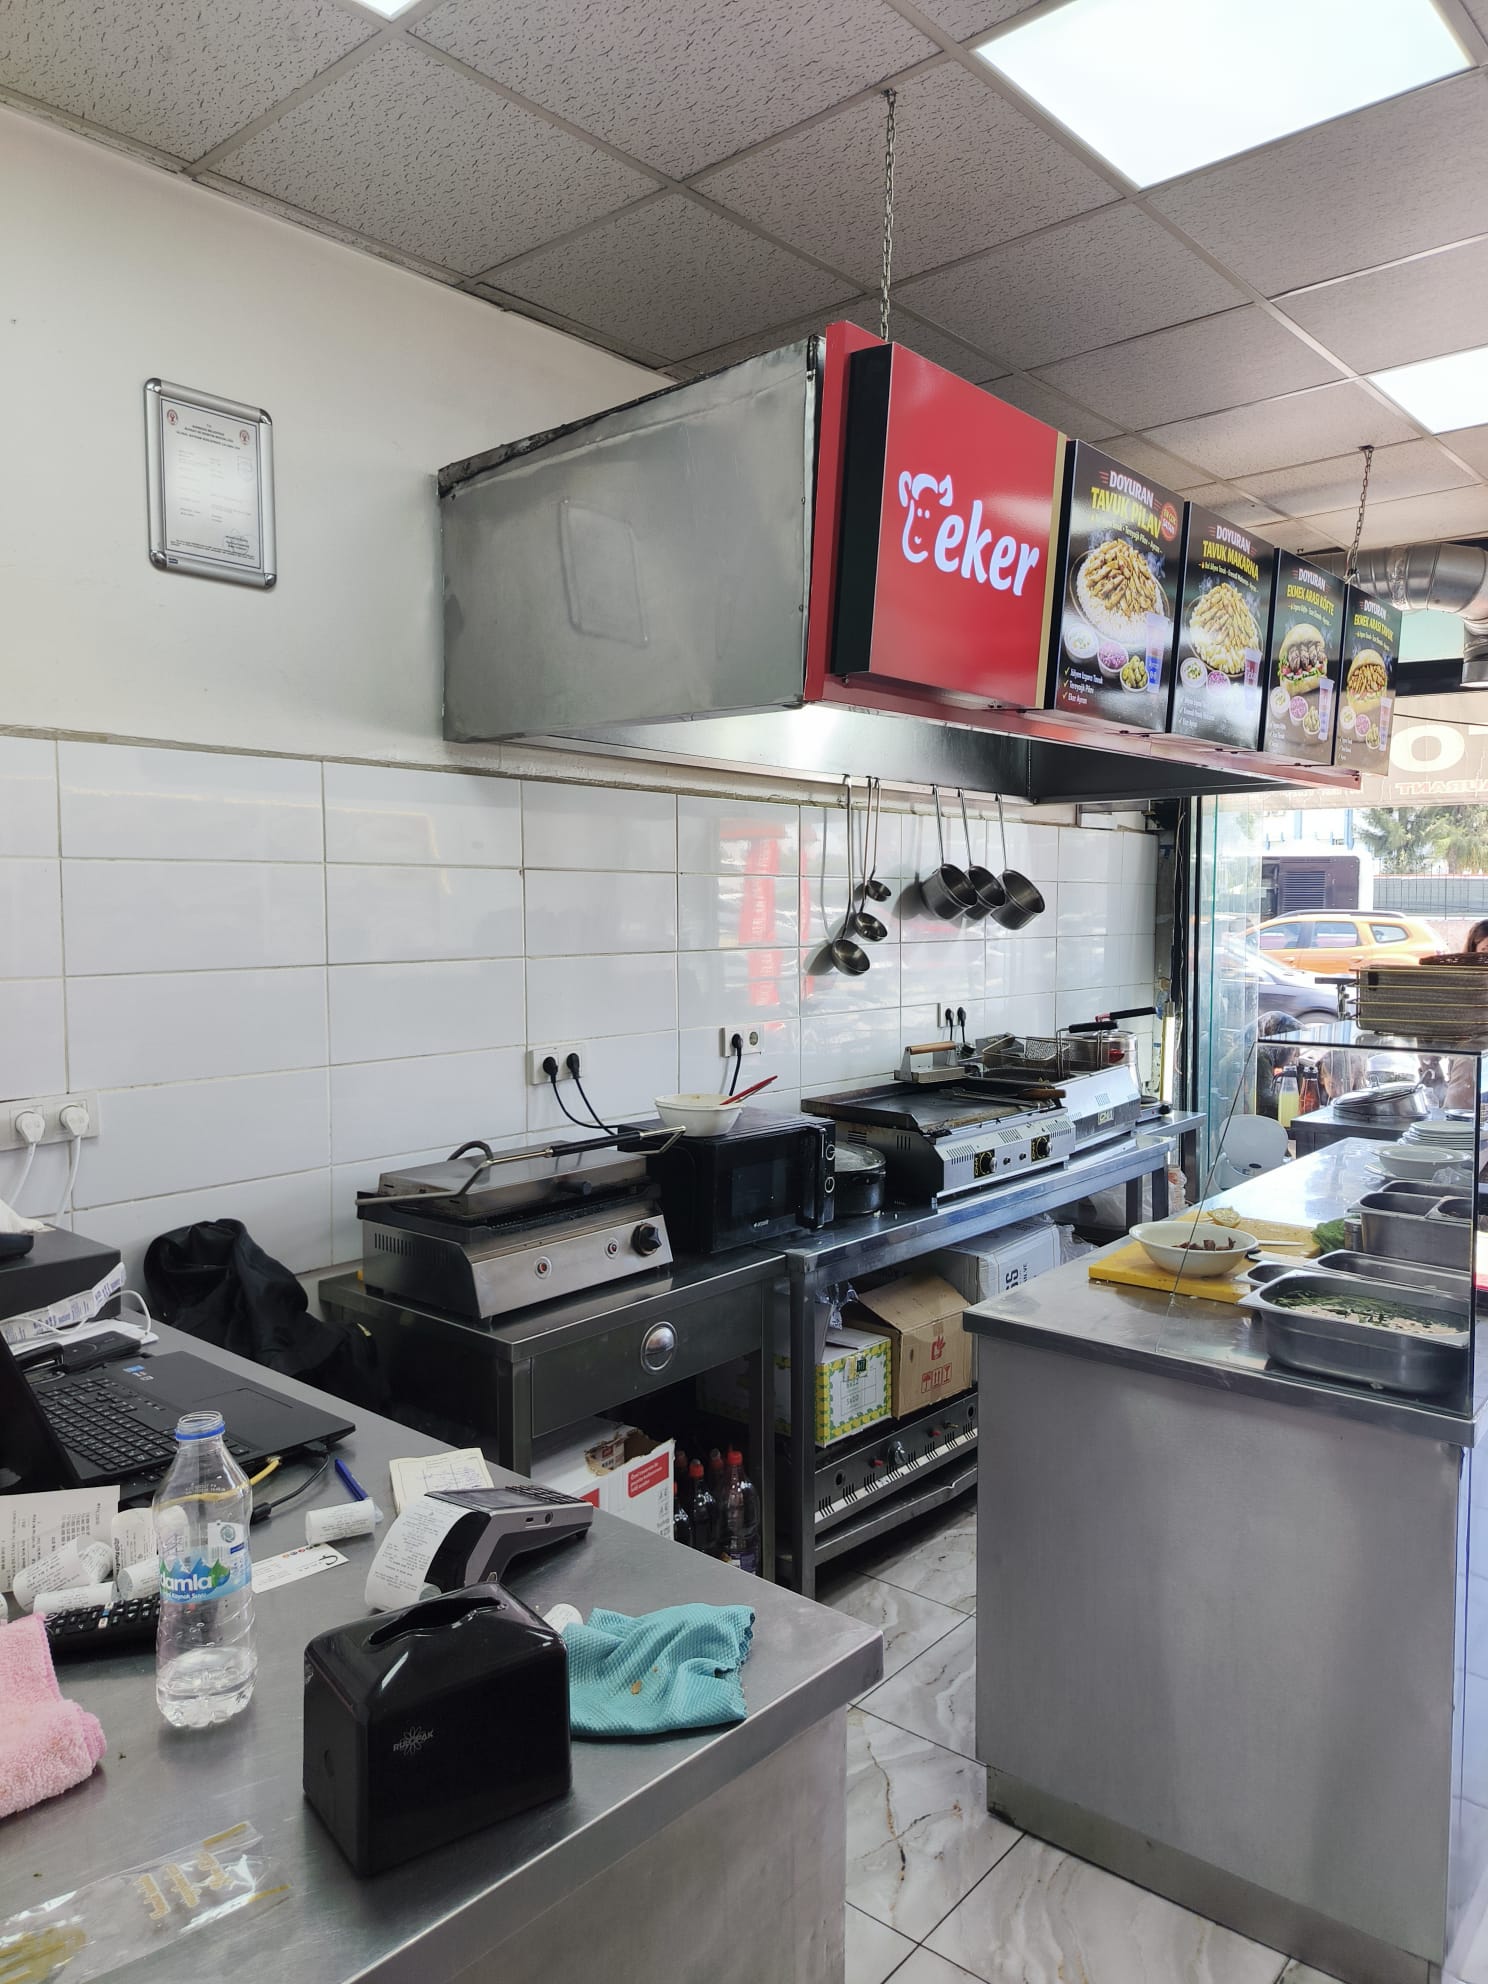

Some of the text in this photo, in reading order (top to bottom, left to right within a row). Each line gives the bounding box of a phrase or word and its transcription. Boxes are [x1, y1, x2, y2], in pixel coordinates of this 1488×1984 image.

[1090, 486, 1129, 516] TAVUK
[1109, 470, 1154, 508] DOYURAN
[1216, 524, 1251, 555] DOYURAN
[1202, 540, 1228, 562] TAVUK
[1227, 548, 1259, 581] MAKARNA
[1298, 568, 1326, 592] DOYURAN
[1287, 584, 1305, 601] EKMEK
[1305, 589, 1320, 607] ARASI
[1364, 599, 1387, 621] DOYURAN
